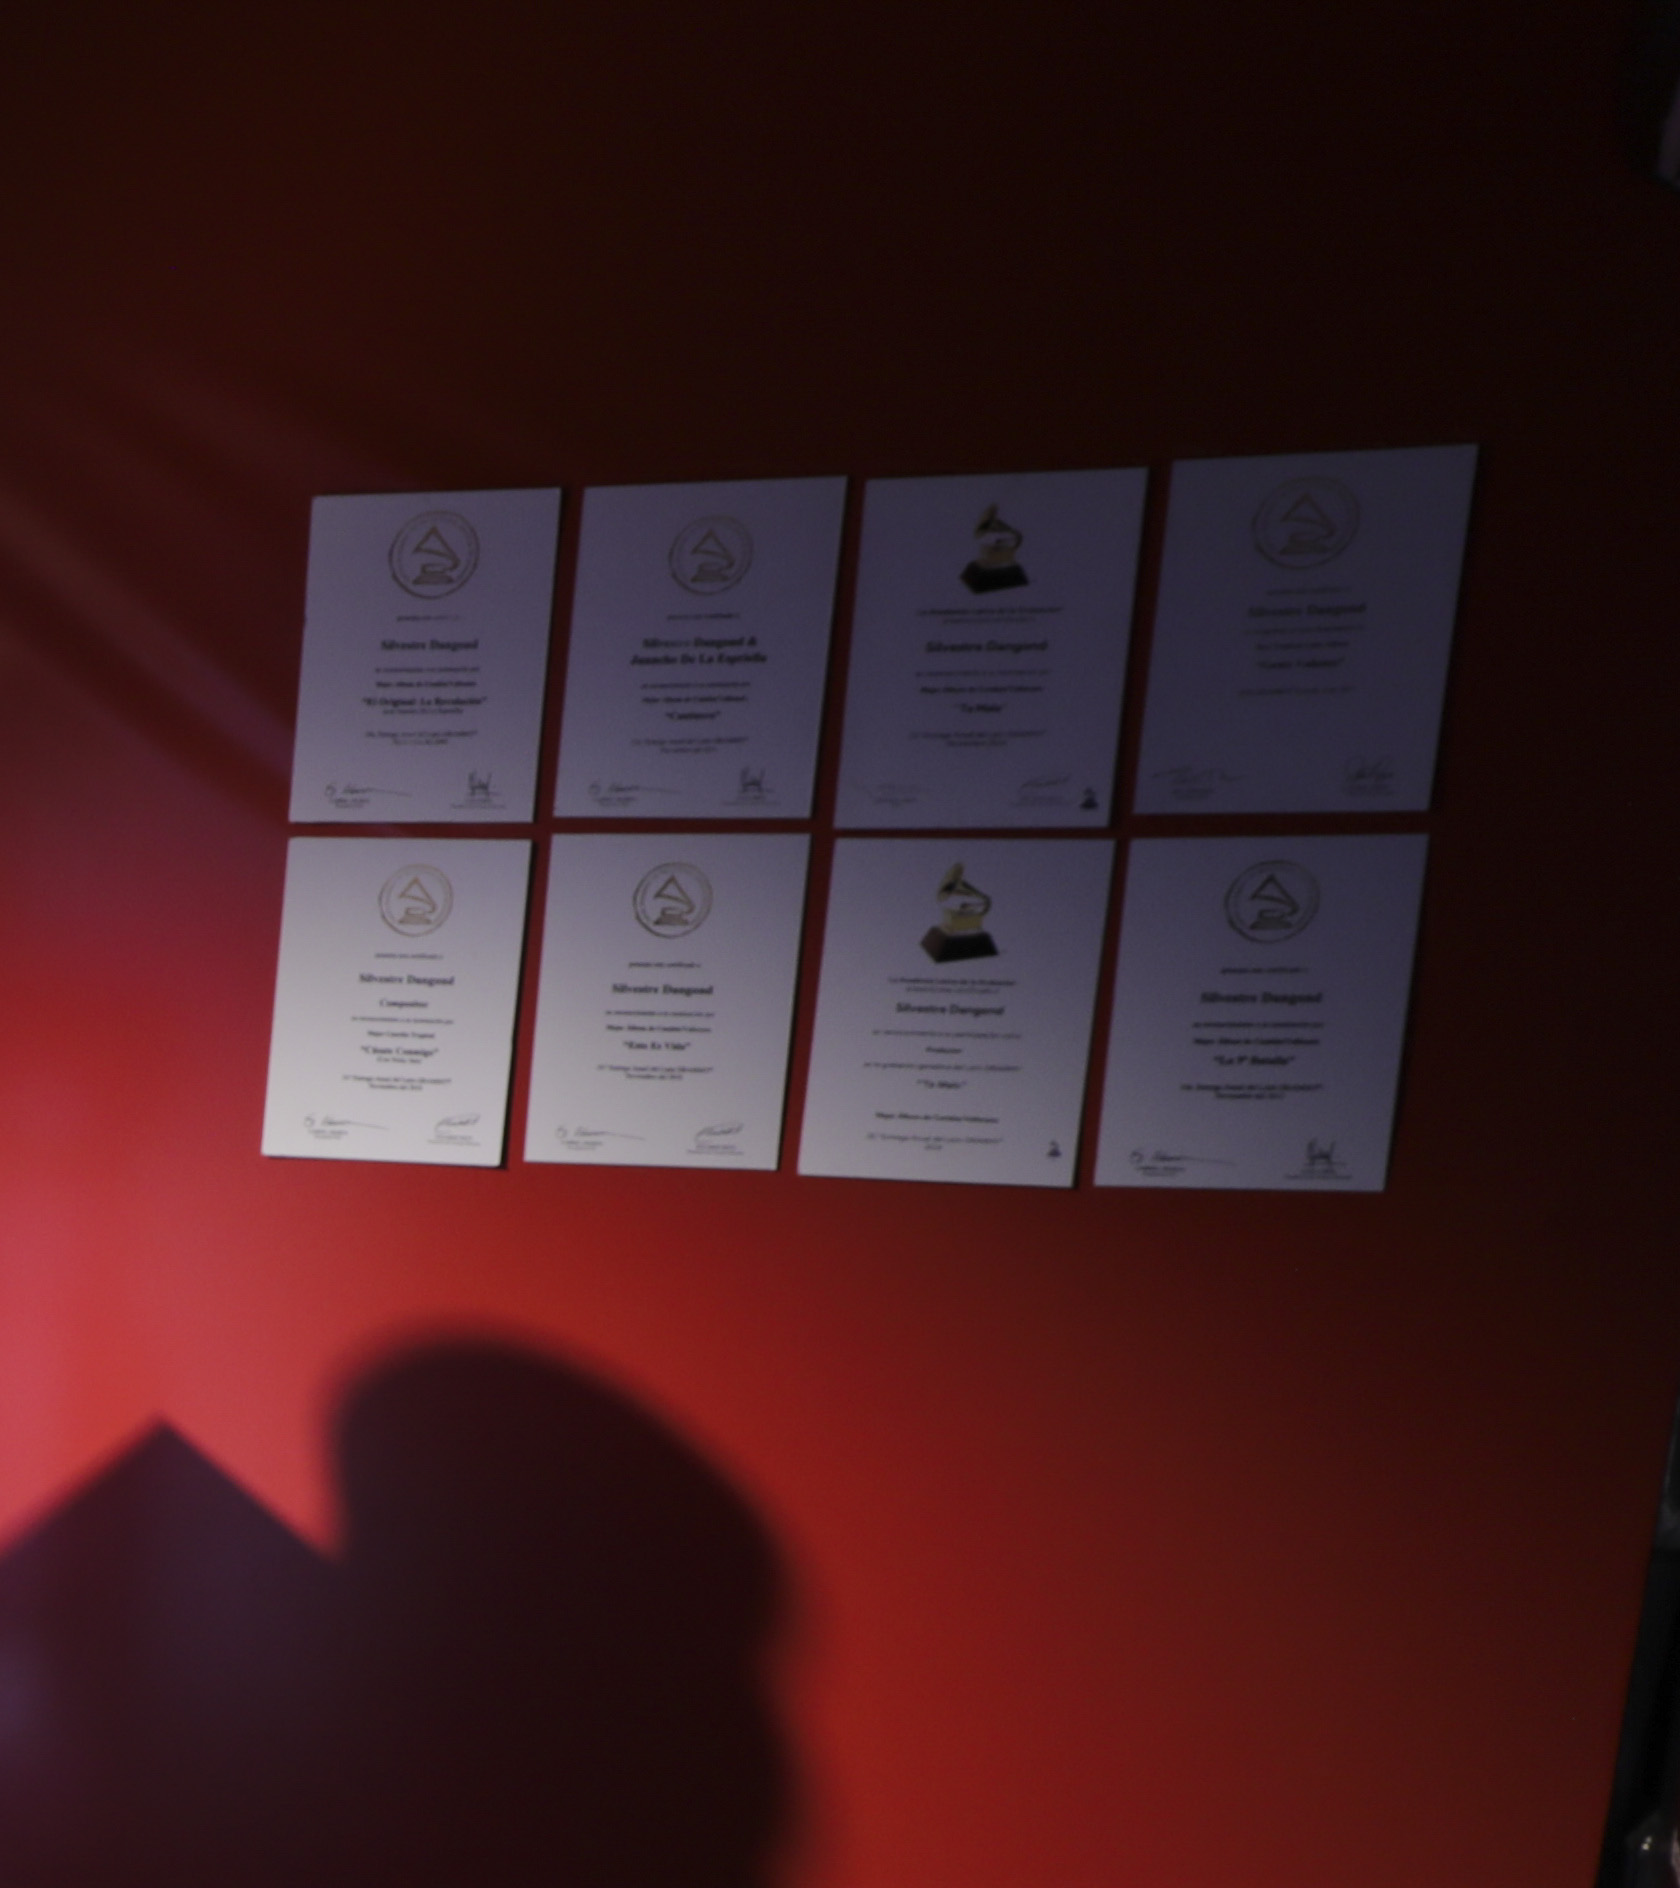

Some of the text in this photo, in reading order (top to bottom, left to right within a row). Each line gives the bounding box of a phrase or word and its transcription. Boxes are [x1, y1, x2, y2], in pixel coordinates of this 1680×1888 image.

[381, 638, 479, 652] Silvestre Dangond
[693, 636, 745, 650] Dangond
[925, 638, 1049, 654] Silvestre Dangond
[359, 972, 455, 988] Silvestre Dangond
[612, 983, 714, 997] Silvestre Dangond
[1200, 991, 1323, 1006] Silvestre Dangond
[895, 1002, 1006, 1018] Silvestre Dangond
